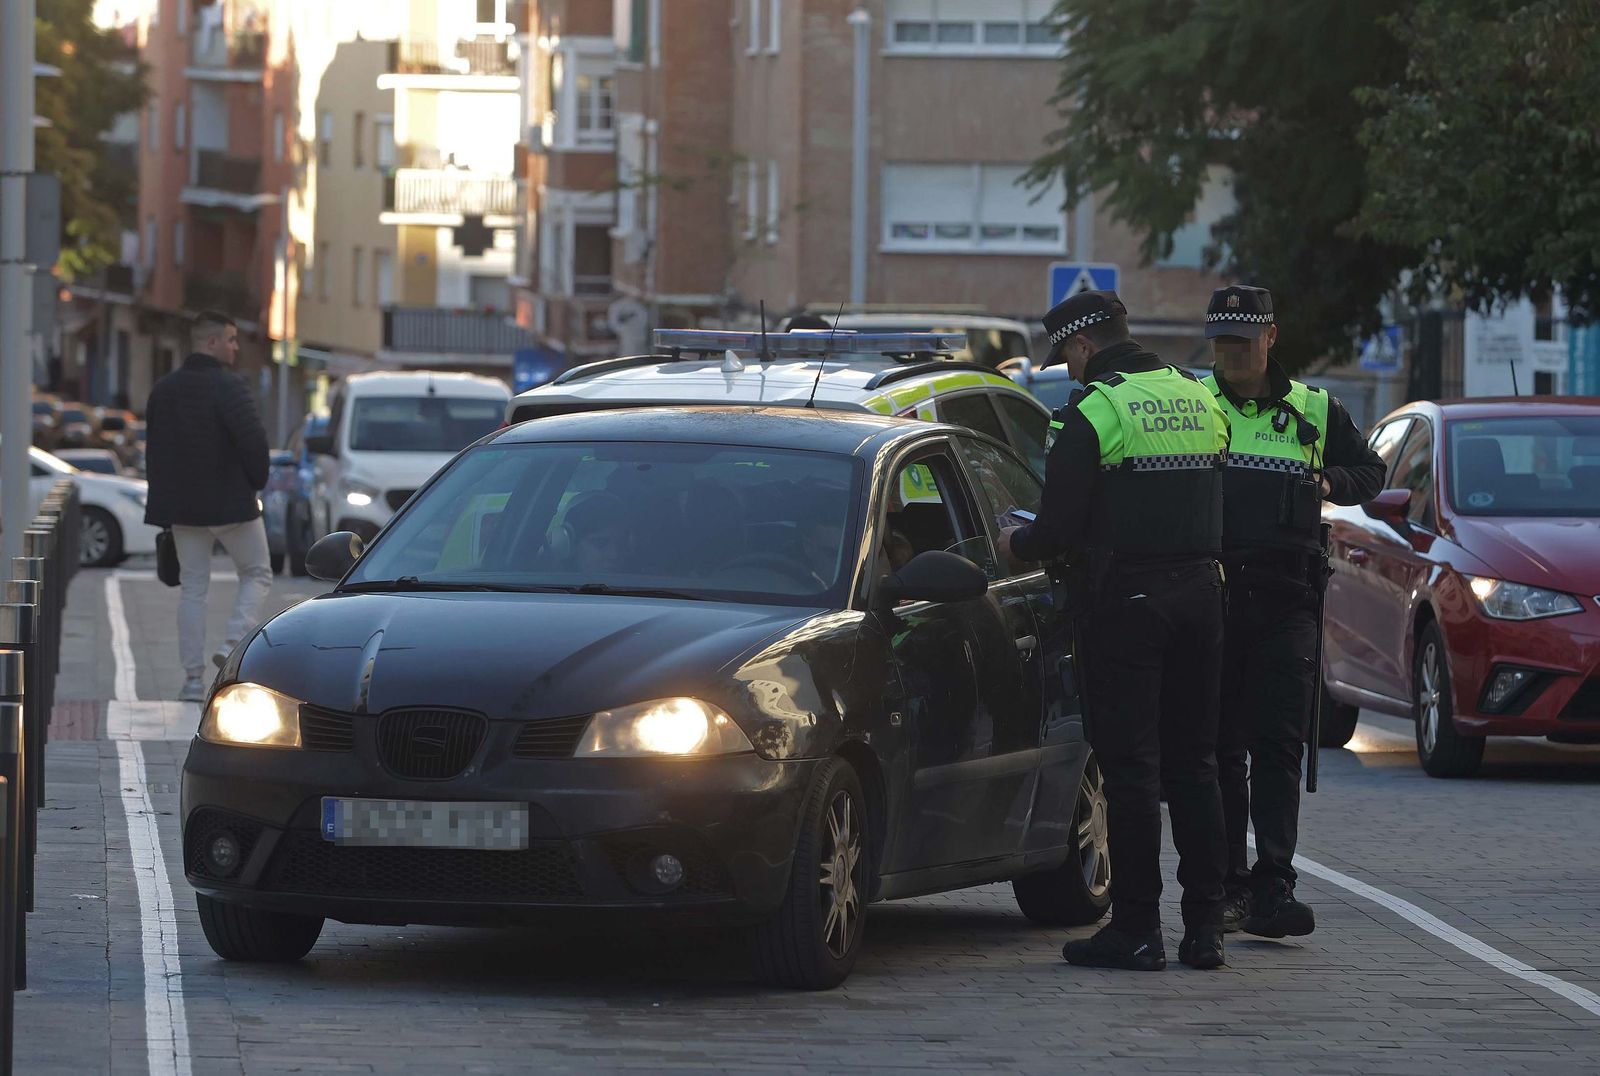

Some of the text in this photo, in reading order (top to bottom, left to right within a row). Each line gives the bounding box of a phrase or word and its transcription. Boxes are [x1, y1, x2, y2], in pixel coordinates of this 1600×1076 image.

[1128, 398, 1207, 416] POLICIA
[1142, 416, 1204, 432] LOCAL
[1255, 432, 1296, 446] POLICIA
[327, 823, 335, 833] E
